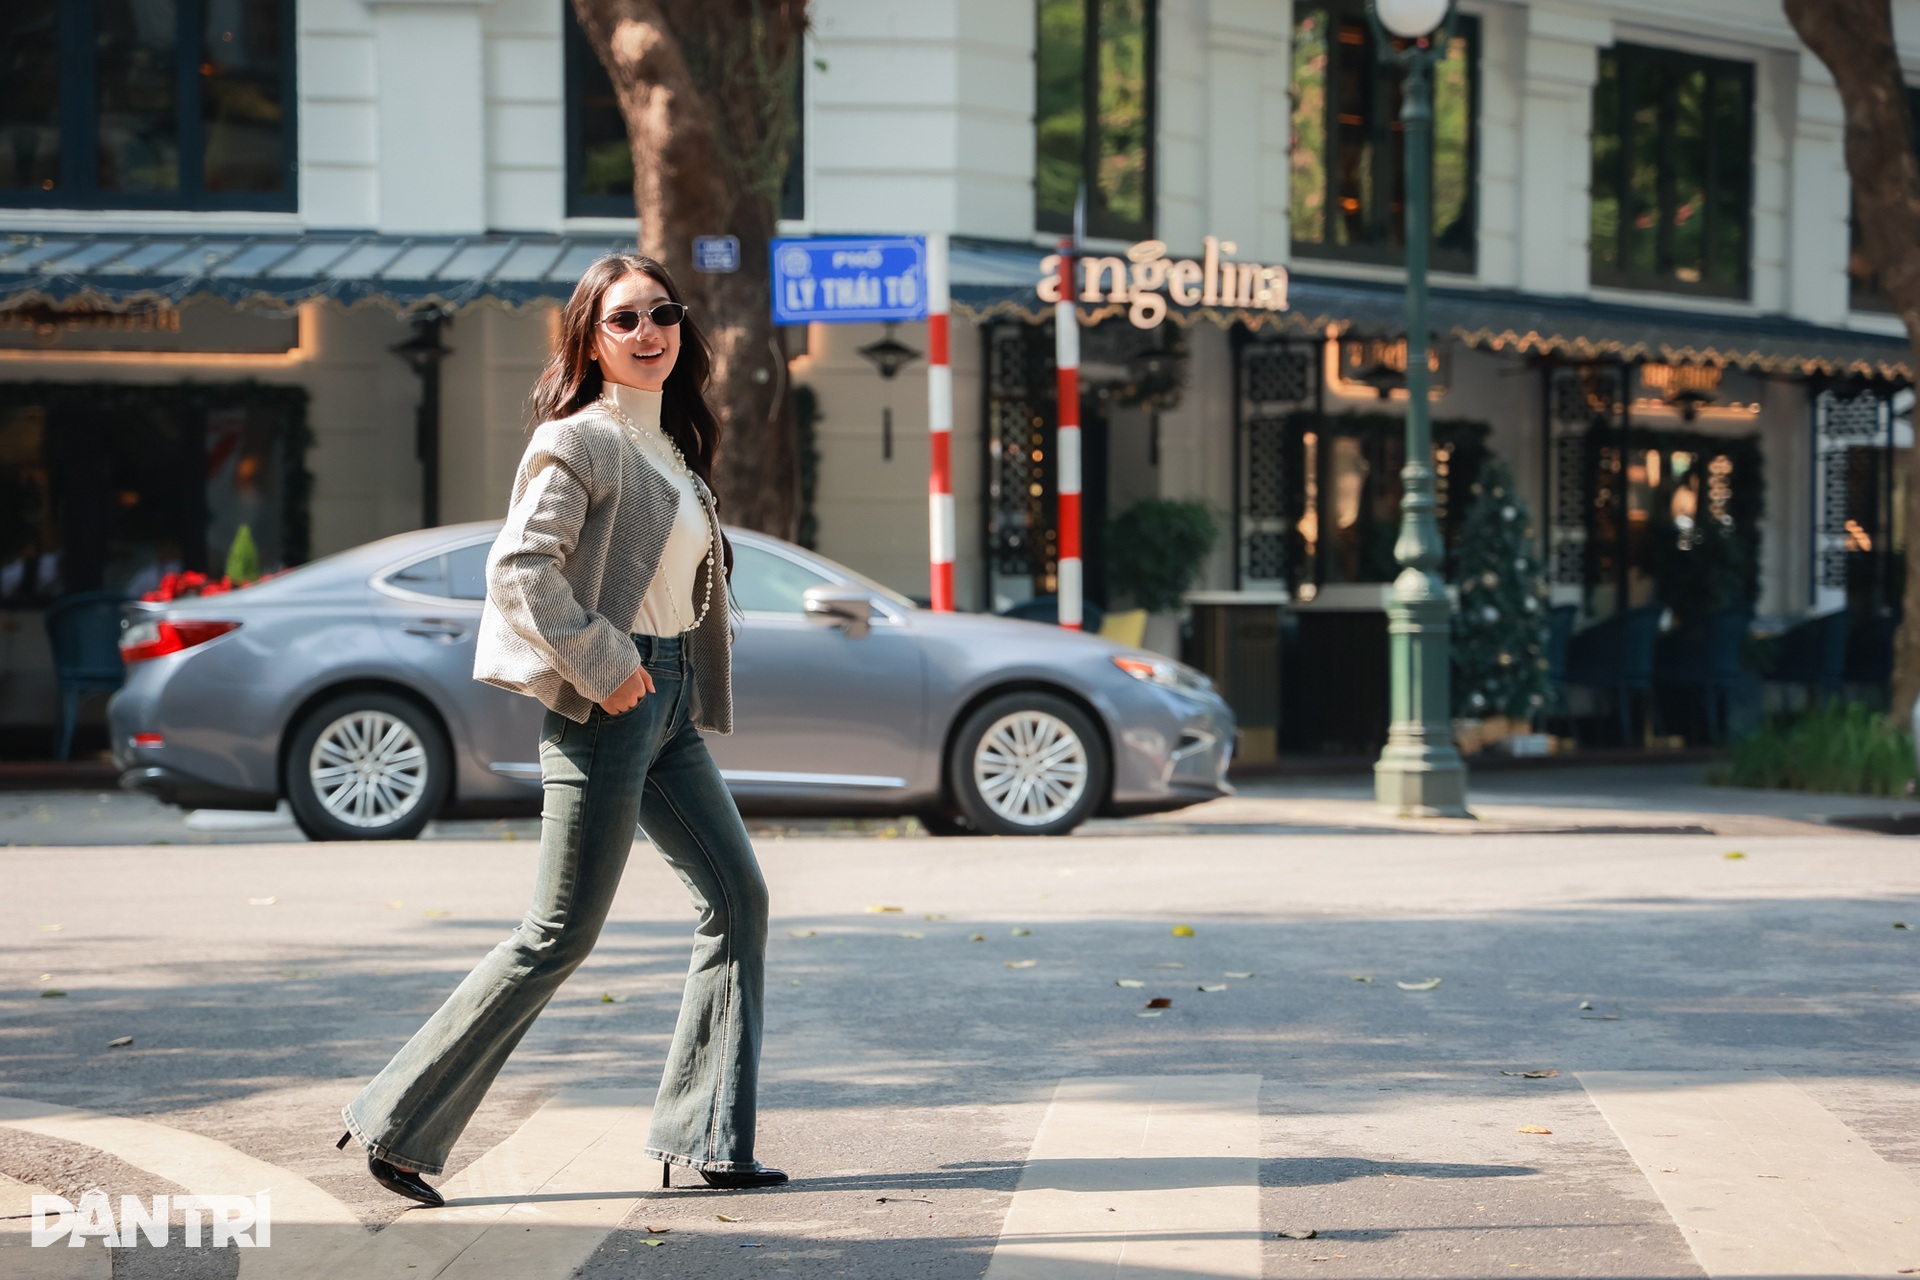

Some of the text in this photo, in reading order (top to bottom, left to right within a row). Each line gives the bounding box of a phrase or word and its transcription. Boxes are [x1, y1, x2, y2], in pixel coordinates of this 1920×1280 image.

[832, 245, 884, 269] PHỐ
[820, 270, 882, 309] THÁI
[1036, 236, 1289, 329] angelina
